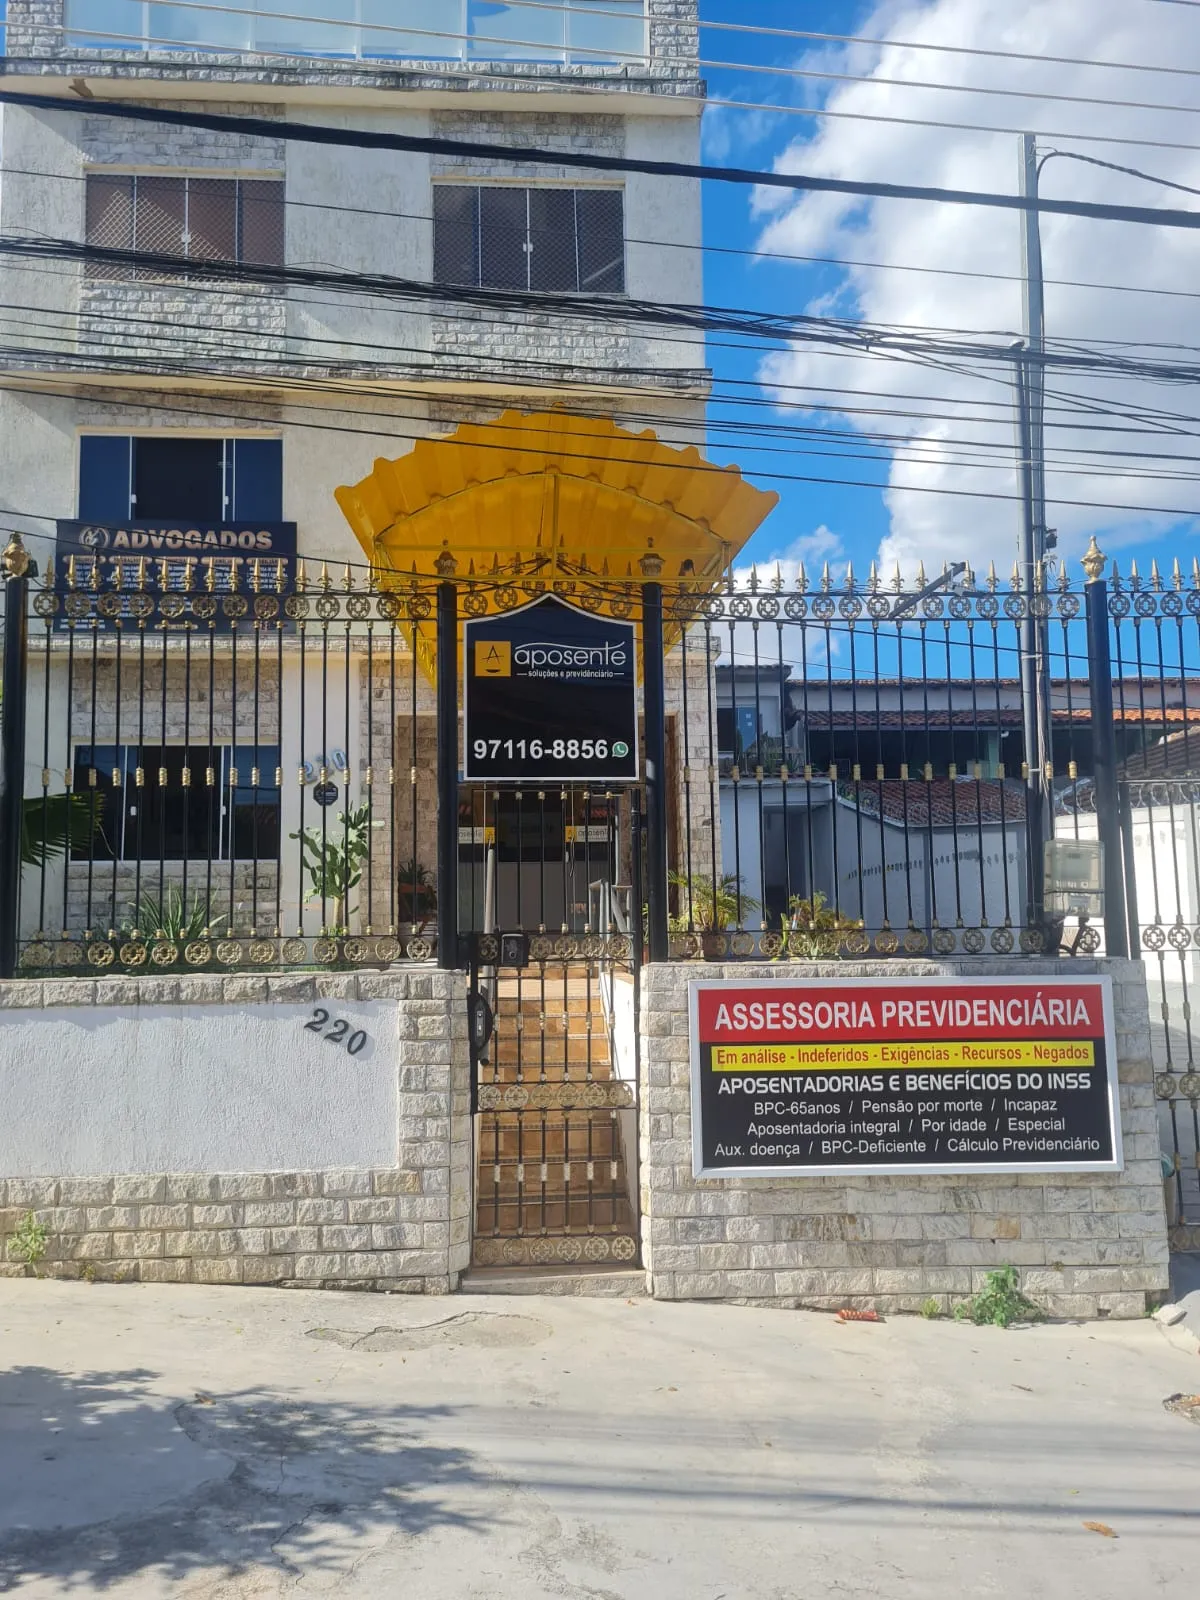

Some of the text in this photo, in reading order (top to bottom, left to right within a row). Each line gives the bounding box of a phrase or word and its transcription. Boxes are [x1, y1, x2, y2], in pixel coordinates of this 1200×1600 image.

[114, 530, 272, 549] ADVOGADOS
[528, 670, 559, 678] soluções
[473, 739, 608, 759] 97116-8856
[715, 992, 1091, 1030] ASSESSORIA PREVIDENCIÁRIA
[304, 1009, 367, 1055] 220
[717, 1049, 738, 1064] Em
[741, 1048, 787, 1064] análise
[797, 1047, 869, 1063] Indeferidos
[880, 1045, 950, 1065] Exigências
[962, 1045, 1022, 1061] Recursos
[1033, 1045, 1089, 1064] Negados
[717, 1070, 1091, 1095] APOSENTADORIAS E BENEFÍCIOS DO INSS
[753, 1100, 841, 1116] BPC-65anos
[861, 1099, 914, 1114] Pensão
[917, 1100, 940, 1116] por
[943, 1099, 983, 1112] morte
[1003, 1097, 1058, 1115] Incapaz
[747, 1120, 847, 1137] Aposentadoria
[850, 1119, 900, 1137] integral
[921, 1118, 946, 1132] Por
[949, 1118, 987, 1132] idade
[1007, 1117, 1066, 1136] Especial
[714, 1142, 746, 1157] Aux.
[750, 1142, 801, 1160] doença
[821, 1138, 927, 1155] BPC-Deficiente
[947, 1137, 999, 1153] Cálculo
[1002, 1136, 1101, 1152] Previdenciário
